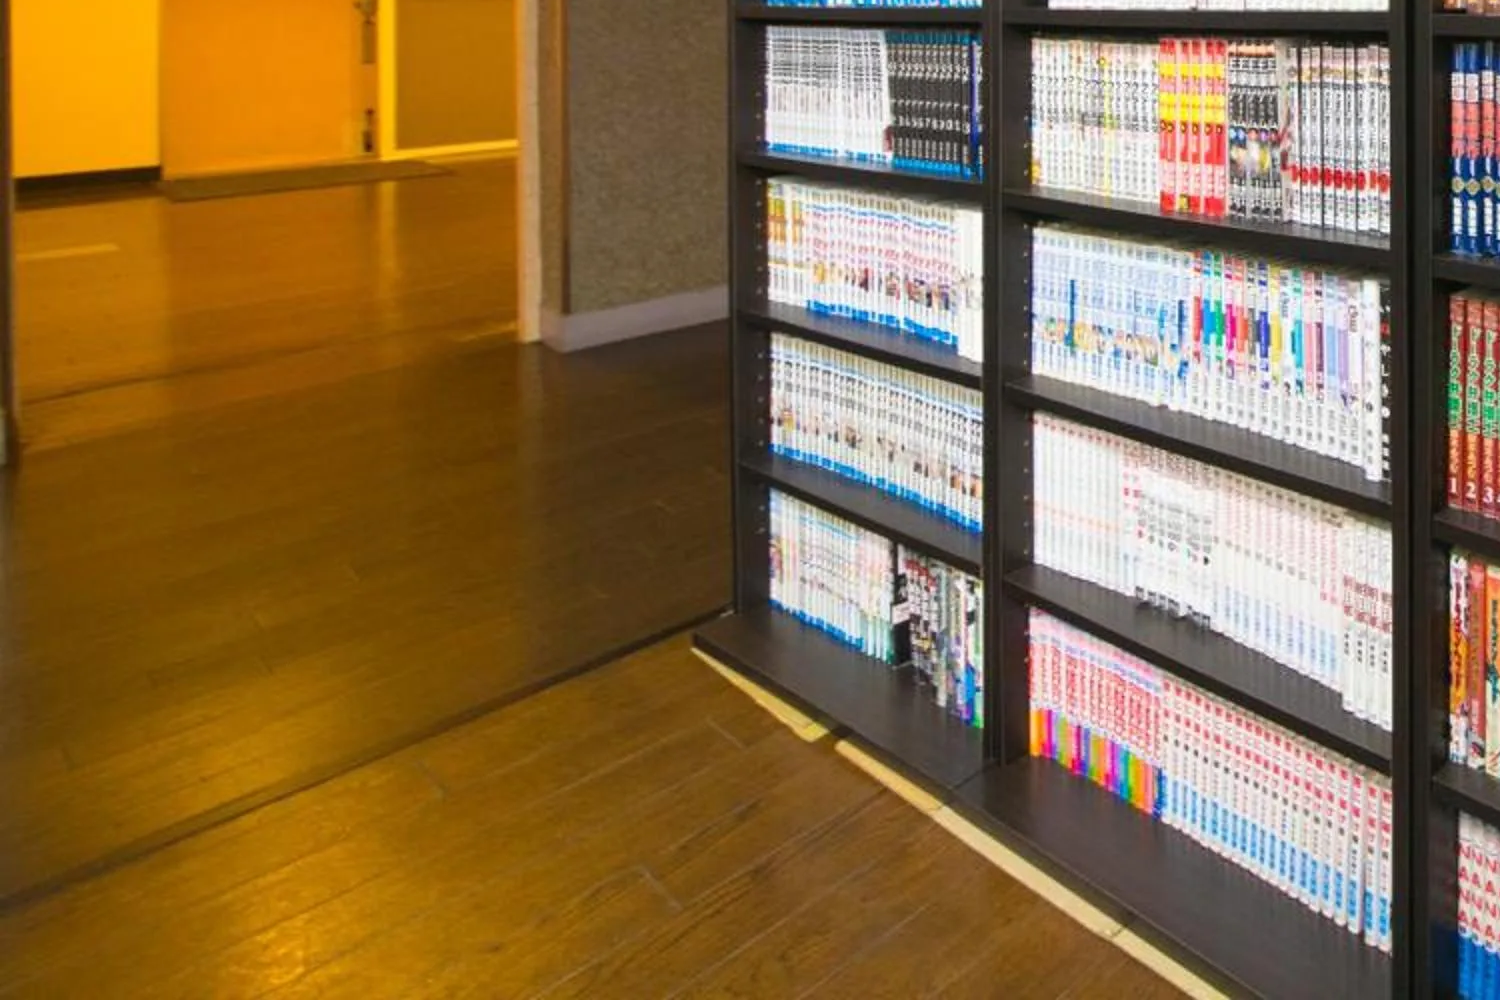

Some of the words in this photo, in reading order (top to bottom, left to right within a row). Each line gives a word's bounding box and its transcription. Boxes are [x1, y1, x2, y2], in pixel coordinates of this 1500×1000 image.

[1451, 478, 1457, 493] 1
[1466, 482, 1476, 497] 2
[1483, 487, 1493, 503] 3
[1459, 842, 1471, 922] NANA
[1472, 849, 1483, 931] NANA
[1485, 856, 1498, 940] NANA
